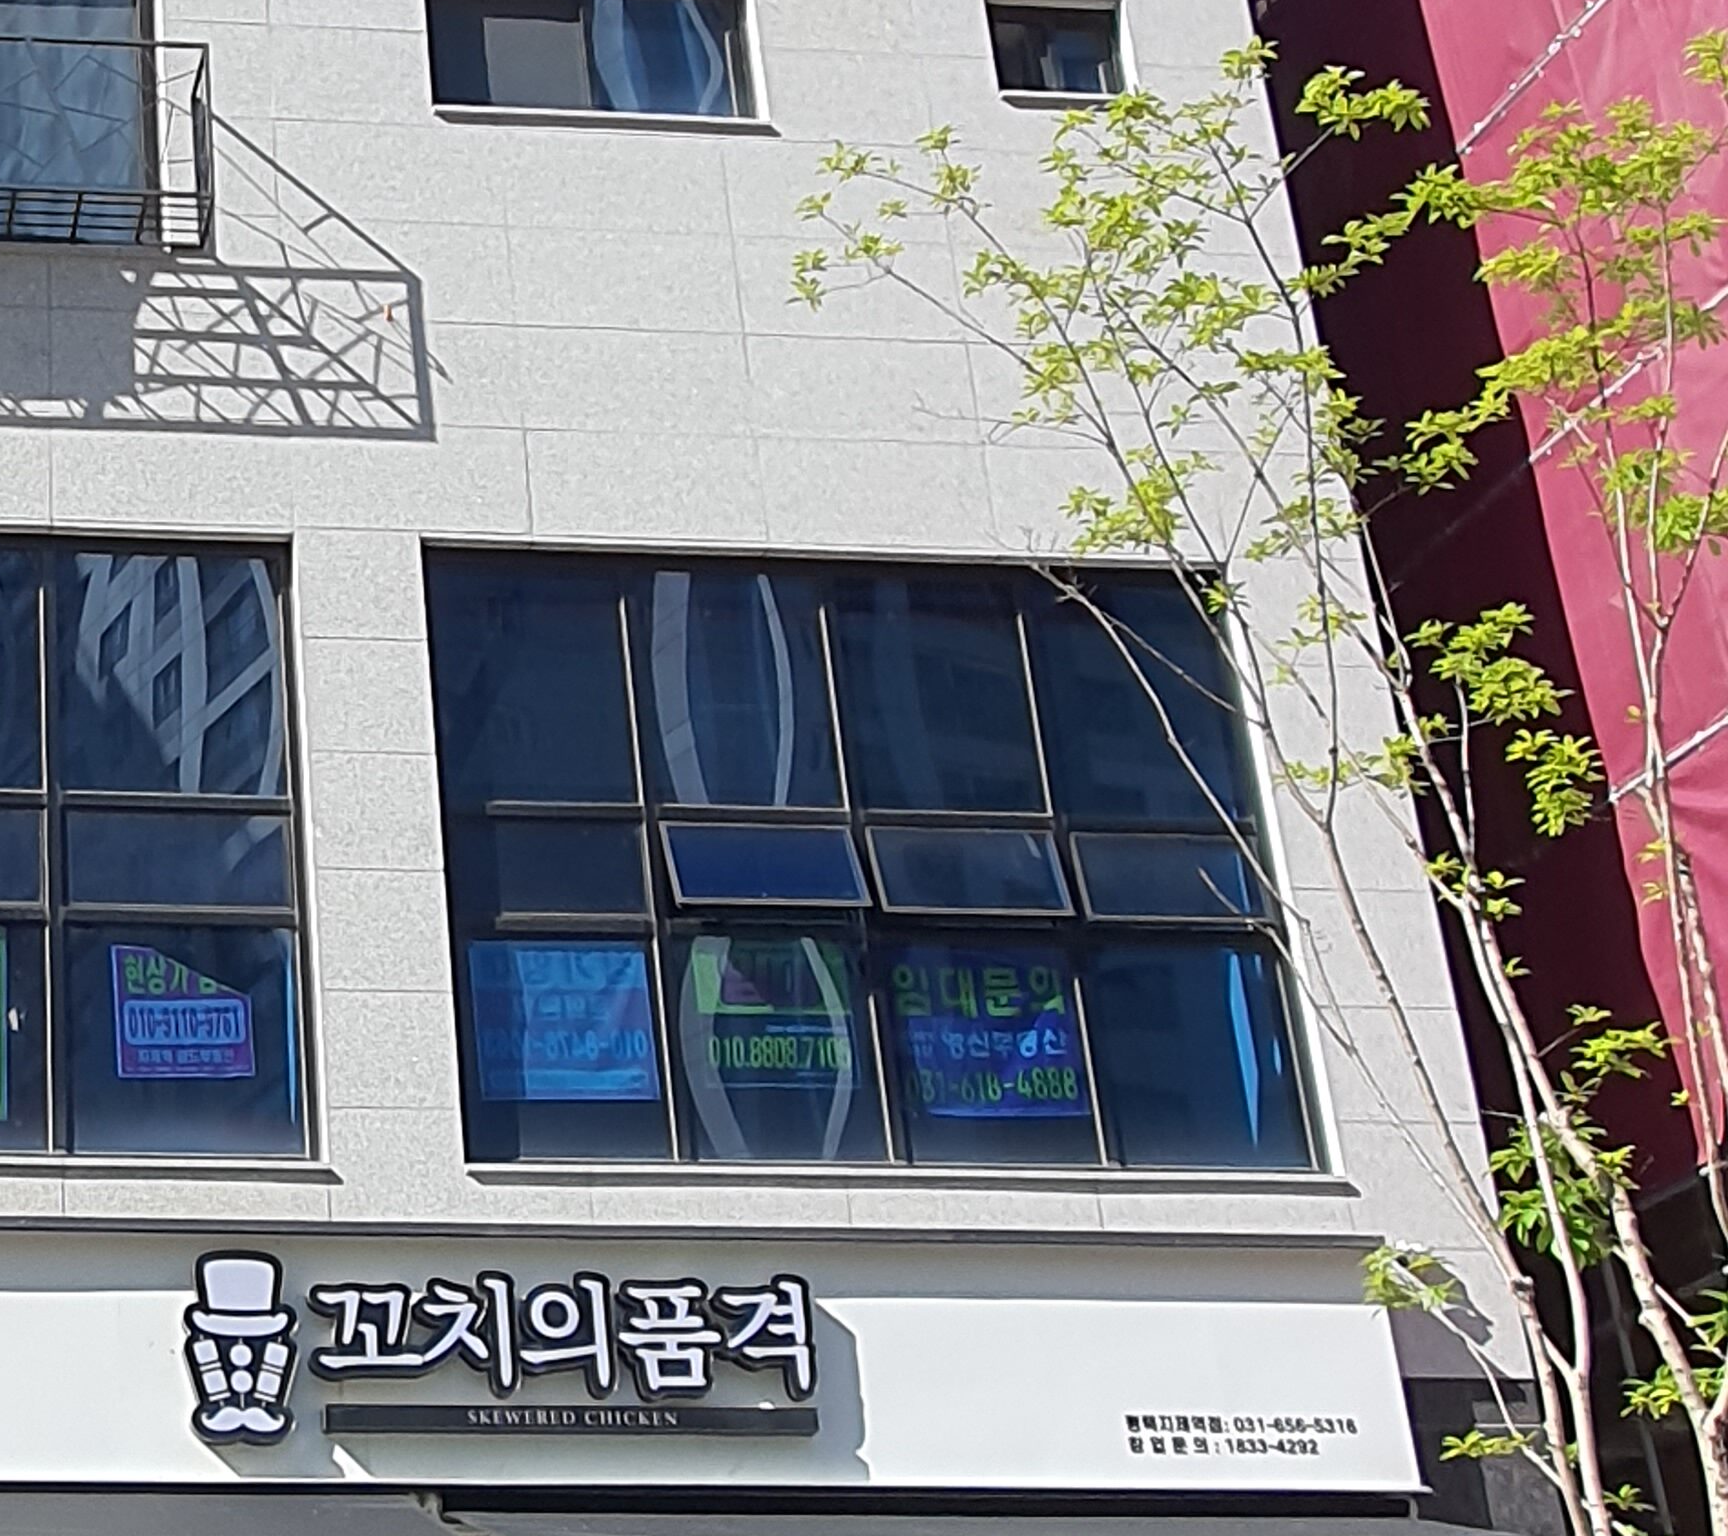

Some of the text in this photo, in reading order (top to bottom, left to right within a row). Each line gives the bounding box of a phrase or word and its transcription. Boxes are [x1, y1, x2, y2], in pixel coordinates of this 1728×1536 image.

[312, 1274, 815, 1396] 꼬치의품격
[466, 1409, 679, 1428] SKEWERED CHICKEN
